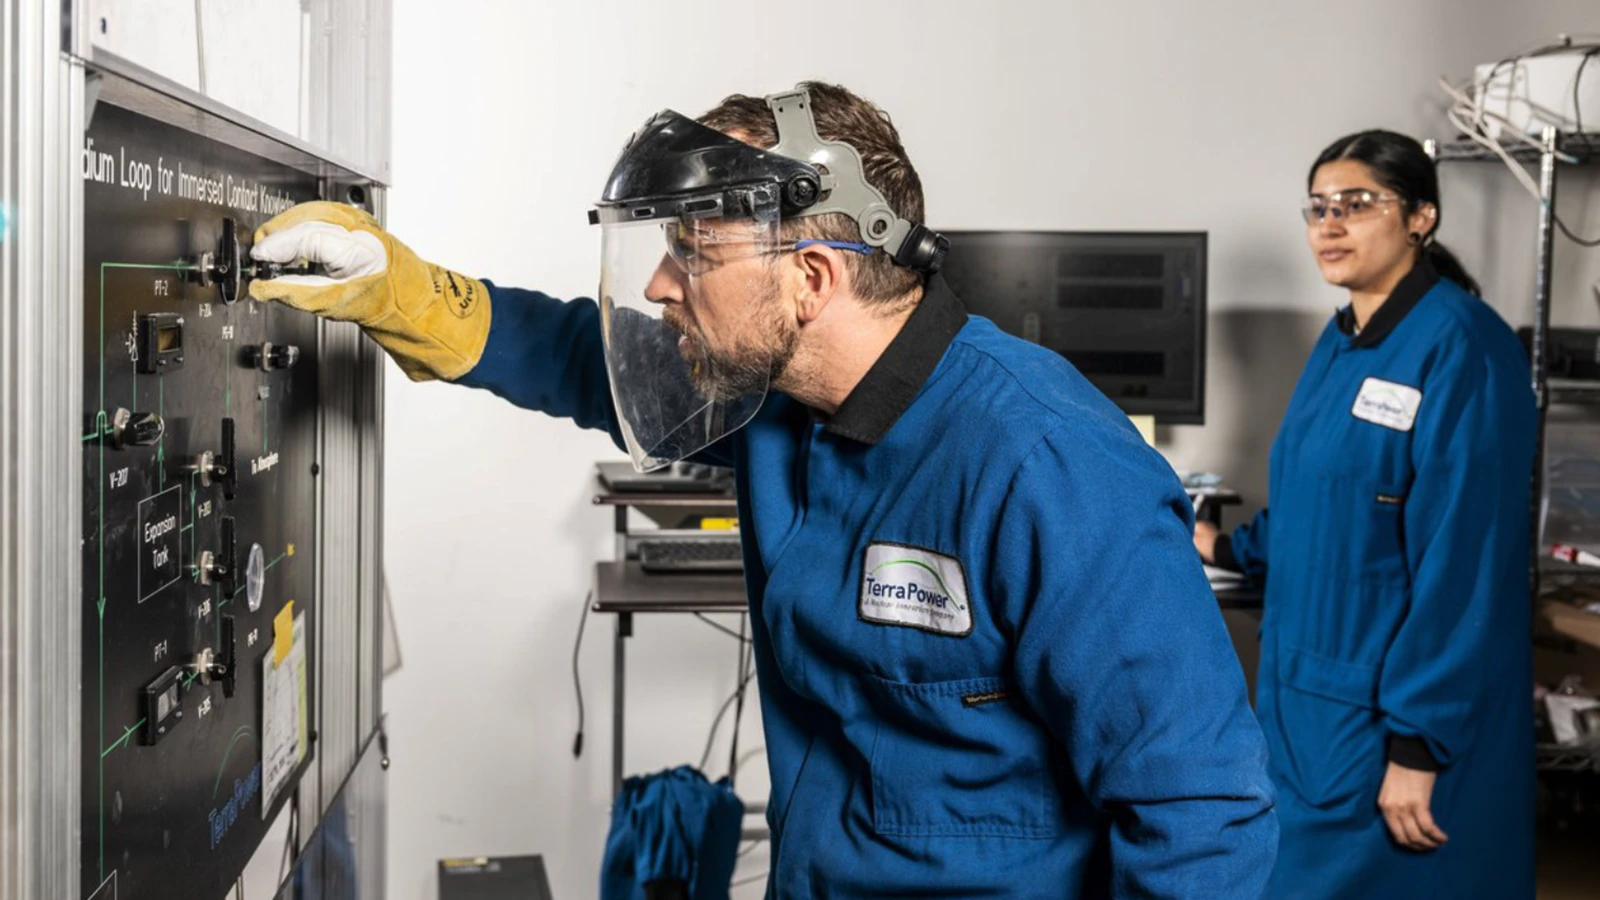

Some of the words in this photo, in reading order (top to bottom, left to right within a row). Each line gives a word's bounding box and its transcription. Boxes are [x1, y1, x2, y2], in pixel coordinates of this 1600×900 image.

[121, 146, 152, 201] Loop
[158, 157, 174, 195] for
[178, 162, 223, 205] Immersed
[227, 174, 258, 212] Contact
[145, 513, 176, 544] Expansion
[153, 545, 169, 570] Tank
[866, 577, 949, 610] TerraPower
